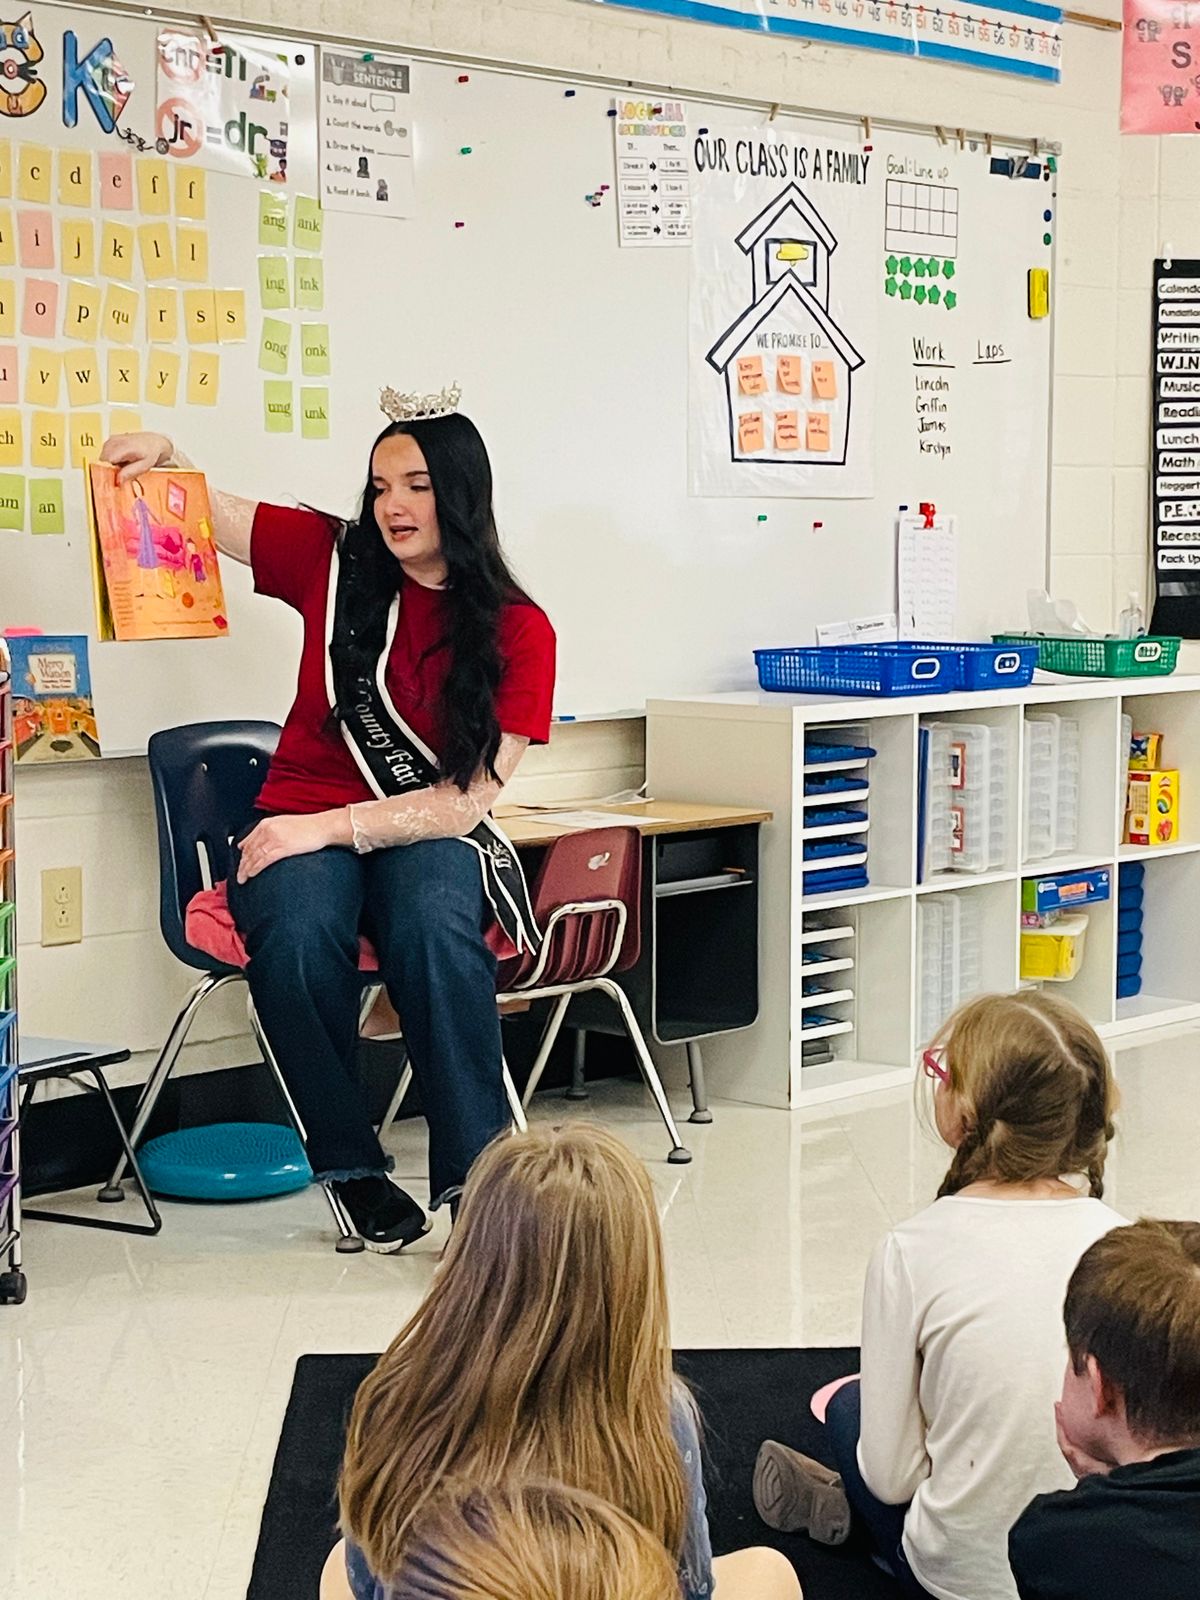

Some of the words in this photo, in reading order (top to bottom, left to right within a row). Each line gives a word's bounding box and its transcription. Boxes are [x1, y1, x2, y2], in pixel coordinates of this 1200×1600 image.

[835, 3, 848, 16] 46
[852, 3, 864, 18] 47
[901, 12, 912, 27] 50
[916, 13, 926, 29] 51
[933, 18, 943, 33] 52
[949, 20, 960, 35] 53
[963, 23, 975, 38] 54
[978, 27, 989, 42] 55
[994, 30, 1005, 45] 56
[1009, 33, 1020, 48] 57
[1024, 36, 1035, 51] 58
[63, 30, 115, 134] K
[353, 72, 403, 89] SENTENCE
[168, 114, 192, 143] jr
[224, 111, 267, 155] dr
[694, 137, 730, 173] OUR
[736, 140, 788, 178] CLASS
[794, 147, 808, 179] IS
[813, 148, 823, 181] A
[827, 149, 870, 185] FAMILY
[886, 154, 913, 175] Goal:
[914, 160, 934, 179] Line
[937, 167, 949, 183] up
[30, 166, 40, 180] c
[70, 166, 82, 184] d
[112, 174, 122, 188] e
[152, 175, 159, 194] f
[189, 181, 196, 199] f
[263, 215, 286, 232] ang
[298, 218, 320, 232] ank
[34, 229, 40, 246] i
[74, 236, 81, 259] j
[112, 238, 123, 258] k
[153, 240, 160, 258] l
[190, 243, 196, 261] l
[266, 277, 286, 294] ing
[300, 277, 319, 291] ink
[35, 302, 46, 315] o
[77, 305, 89, 323] p
[112, 309, 129, 324] qu
[159, 309, 167, 322] r
[196, 310, 206, 323] s
[227, 310, 236, 323] s
[265, 340, 287, 359] ong
[305, 344, 327, 357] onk
[756, 332, 769, 349] WE
[771, 332, 807, 349] PROMISE
[912, 337, 945, 360] Work
[978, 339, 1004, 359] Laps
[39, 370, 50, 384] v
[75, 370, 91, 384] w
[118, 368, 130, 383] x
[156, 371, 169, 389] y
[199, 372, 208, 385] z
[1164, 381, 1200, 392] Music
[268, 402, 291, 417] ung
[305, 406, 327, 420] unk
[40, 433, 57, 447] sh
[80, 432, 94, 447] th
[1162, 433, 1199, 444] Lunch
[1161, 457, 1195, 468] Math
[39, 503, 56, 514] an
[1164, 504, 1187, 518] P.E.
[1161, 554, 1184, 564] Pack
[385, 750, 423, 786] Fair
